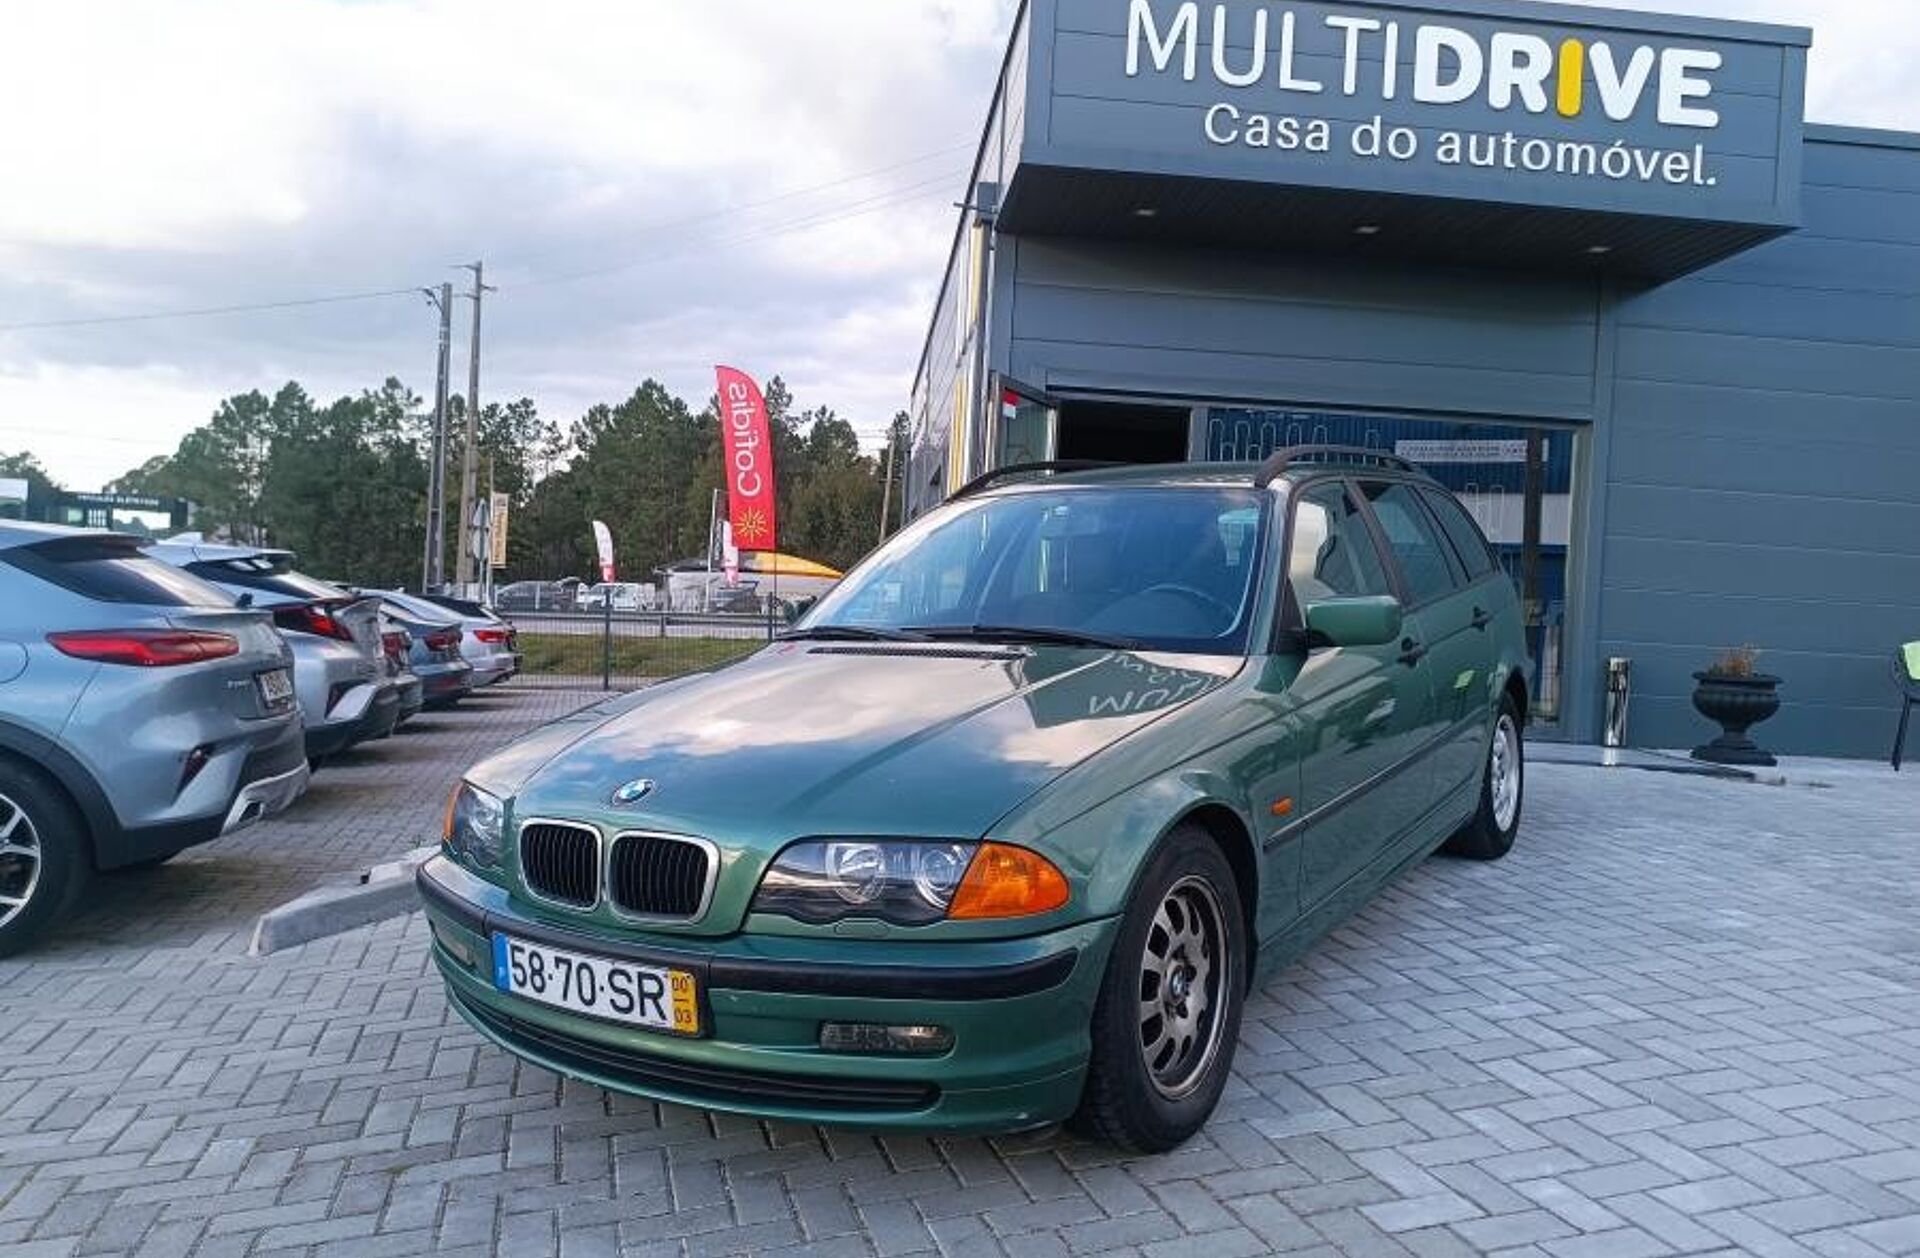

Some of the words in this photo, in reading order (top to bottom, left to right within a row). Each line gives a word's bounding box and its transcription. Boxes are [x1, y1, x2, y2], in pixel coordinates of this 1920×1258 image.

[1125, 0, 1722, 127] MULTIDRIVE
[1204, 103, 1331, 153] Casa
[1351, 115, 1418, 161] do
[1436, 130, 1717, 187] automóvel.
